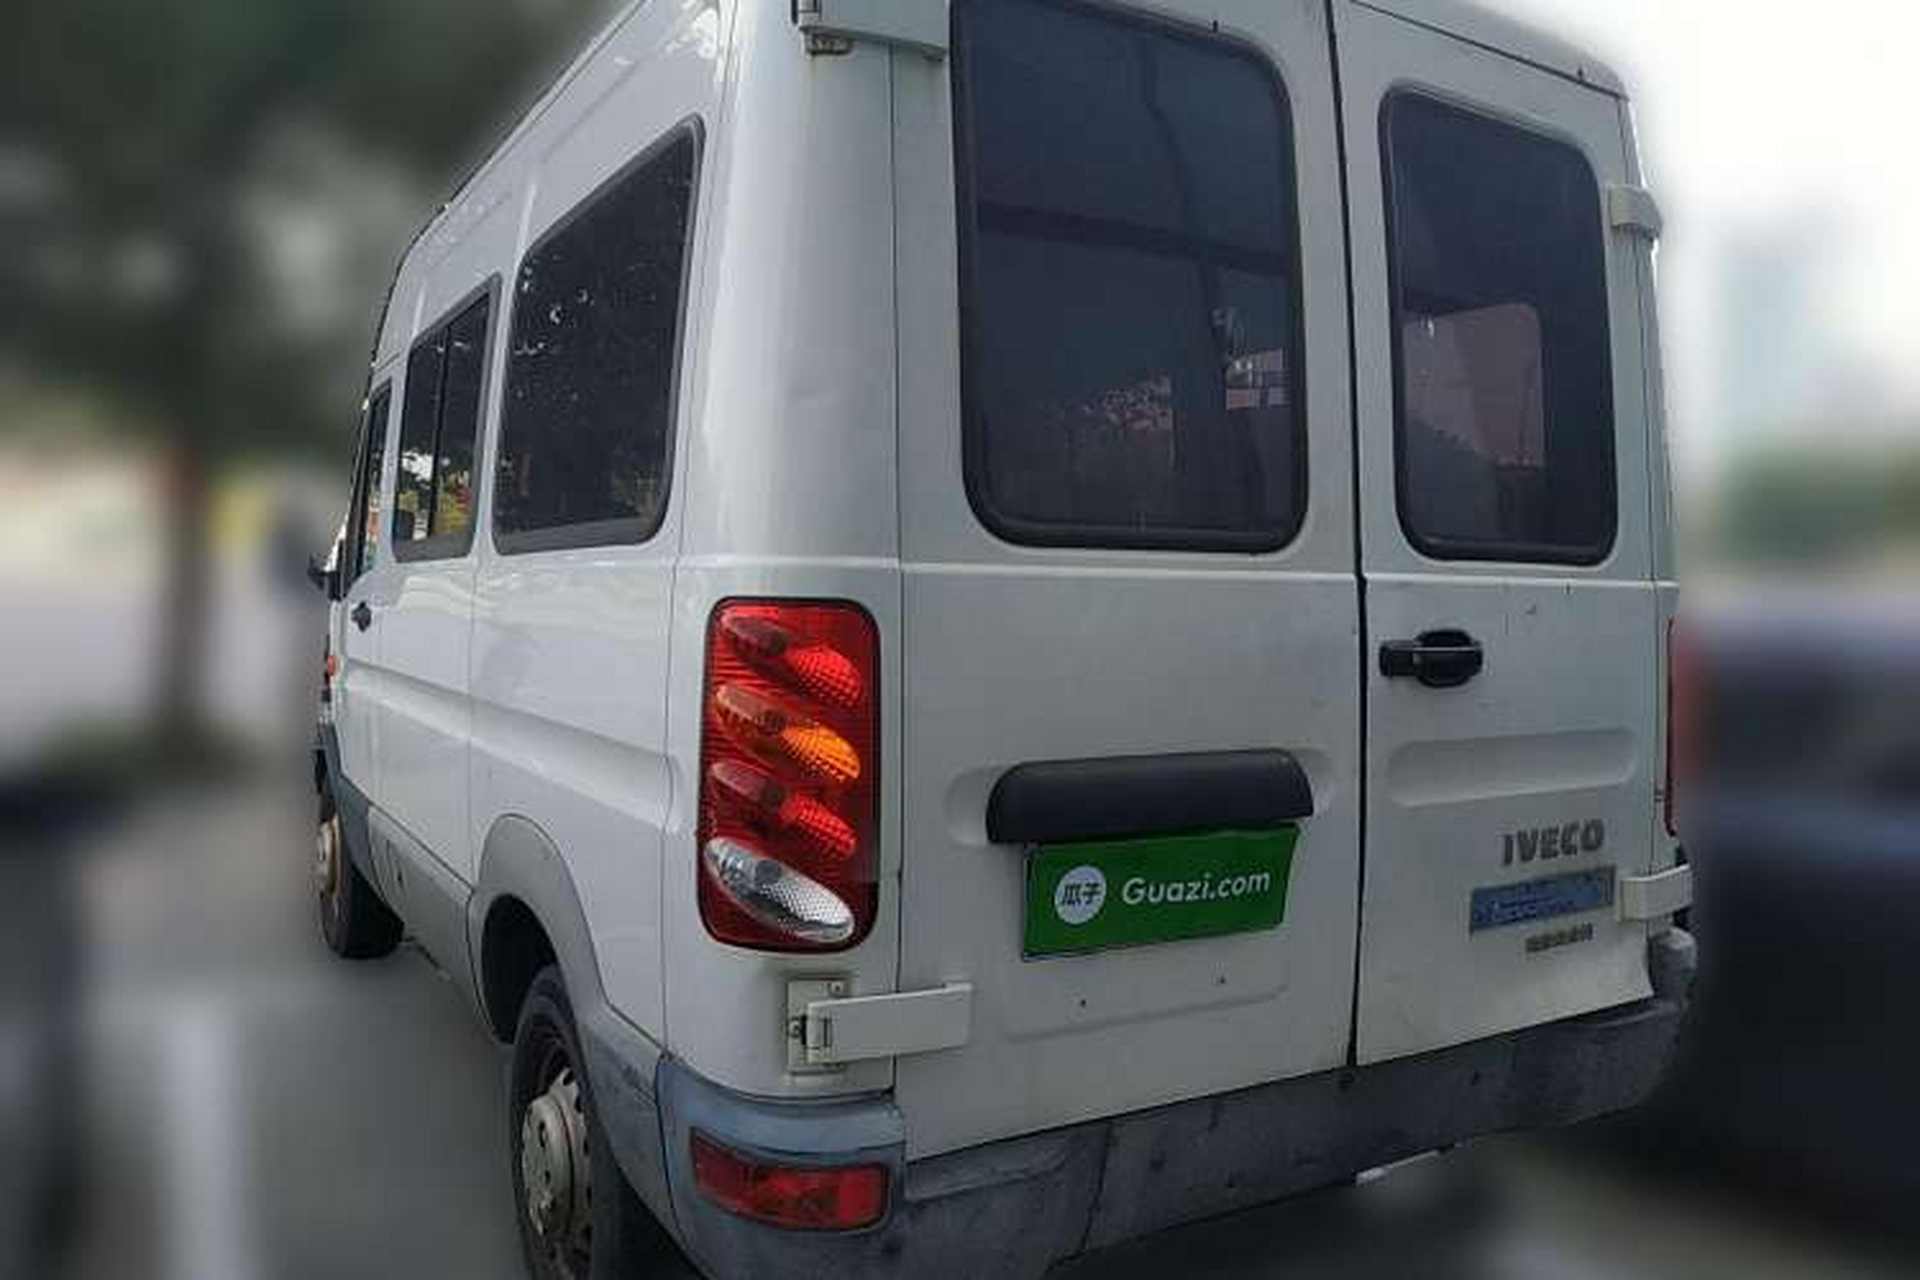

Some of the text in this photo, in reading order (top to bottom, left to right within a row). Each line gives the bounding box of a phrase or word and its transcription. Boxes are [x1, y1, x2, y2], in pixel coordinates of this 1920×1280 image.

[1503, 818, 1605, 866] IVECO
[1062, 871, 1271, 905] 瓜子 Guazi.com
